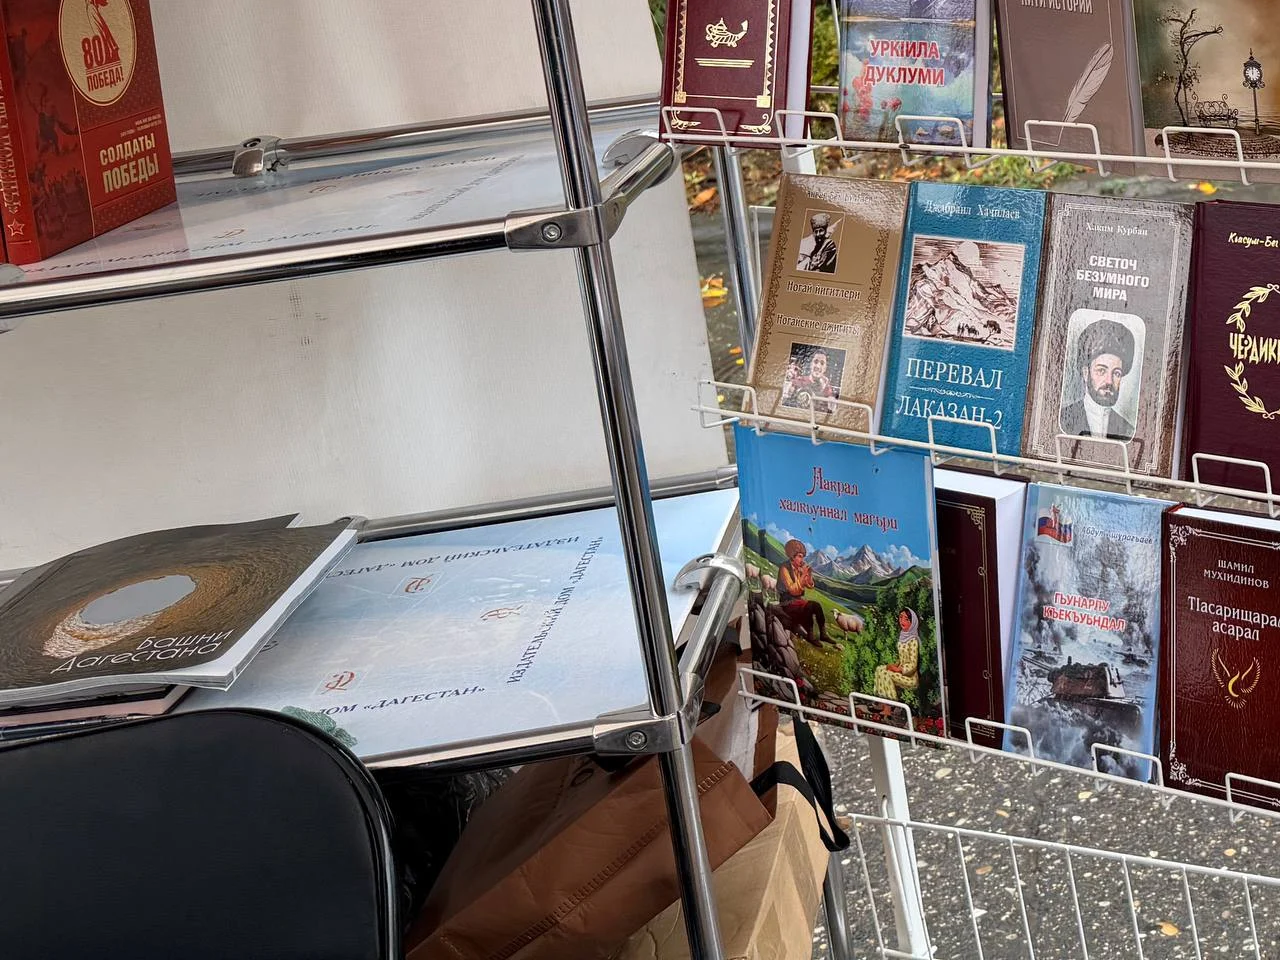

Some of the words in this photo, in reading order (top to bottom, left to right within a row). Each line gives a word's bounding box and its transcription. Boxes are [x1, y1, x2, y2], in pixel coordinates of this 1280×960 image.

[86, 73, 124, 93] ПОБЕДА!
[863, 65, 946, 87] ДУКЛУМИ
[99, 133, 156, 167] СОЛДАТЫ
[102, 154, 160, 194] ПОБЕДЫ
[1117, 225, 1148, 236] Курбан
[1089, 255, 1137, 270] СВЕТОЧ
[786, 280, 813, 294] Ногай
[1076, 270, 1150, 288] БЕЗУМНОГО
[1093, 286, 1127, 301] МИРА
[776, 314, 820, 330] Ногайские
[905, 357, 1003, 390] ПЕРЕВАЛ
[896, 395, 1003, 429] ЛАКАЗАН-2
[444, 536, 581, 564] ИЗДАТЕЛЬСКИЙ
[399, 555, 442, 570] ДОМ
[1218, 559, 1255, 574] ШАМИЛ
[136, 628, 236, 651] Башни
[1212, 620, 1260, 641] асарал
[507, 609, 563, 684] ИЗДАТЕЛЬСКИЙ
[50, 640, 223, 675] Дагестана
[362, 685, 487, 710] «ДАГЕСТАН»
